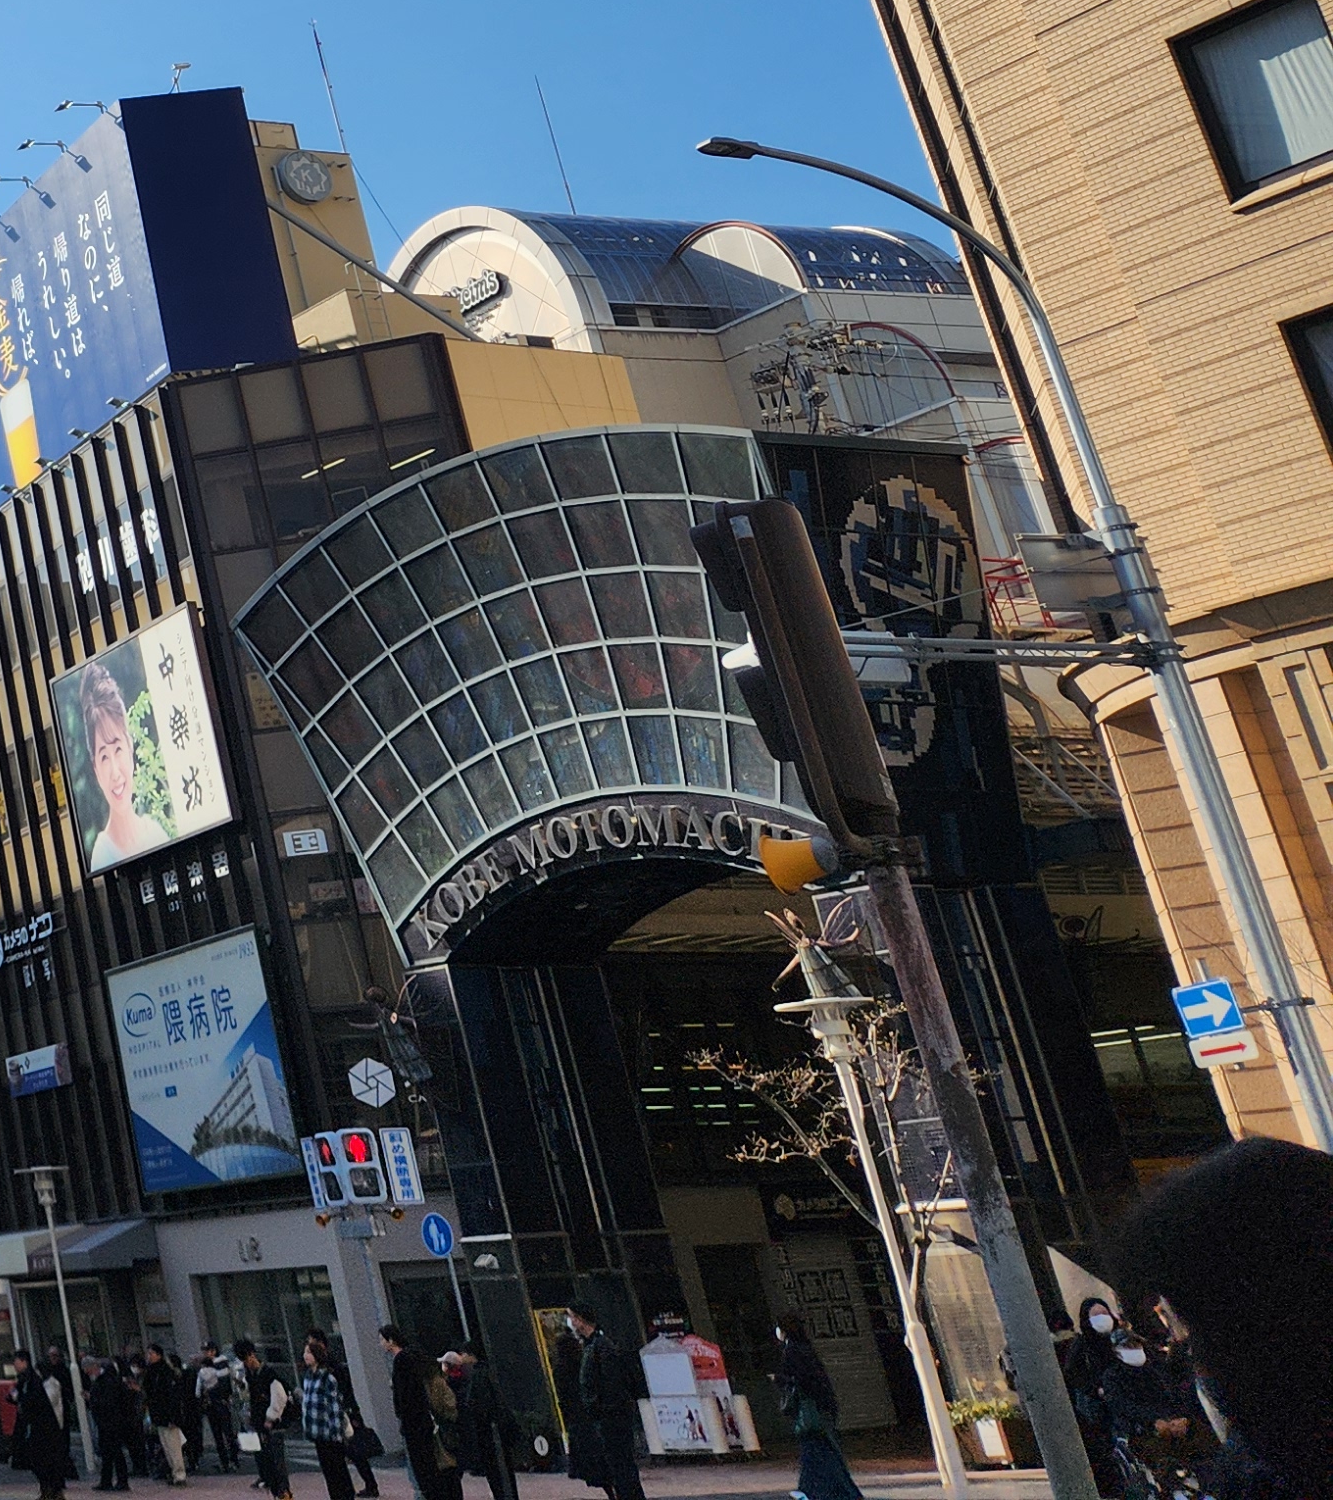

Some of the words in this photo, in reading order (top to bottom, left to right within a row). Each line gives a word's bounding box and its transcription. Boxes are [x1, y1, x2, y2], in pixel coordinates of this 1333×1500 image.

[78, 213, 109, 312] なのに、
[94, 190, 125, 291] 同じ道
[11, 273, 39, 365] 帰れば、
[37, 251, 72, 379] うれしい。
[53, 231, 86, 358] 帰り道は
[409, 848, 510, 951] KOBE
[506, 804, 812, 876] MOTOMACH
[126, 1004, 153, 1027] Kuma
[128, 1041, 162, 1055] HOSPITAL
[162, 984, 238, 1046] 隈病院
[388, 1131, 416, 1200] 斜め横断専用
